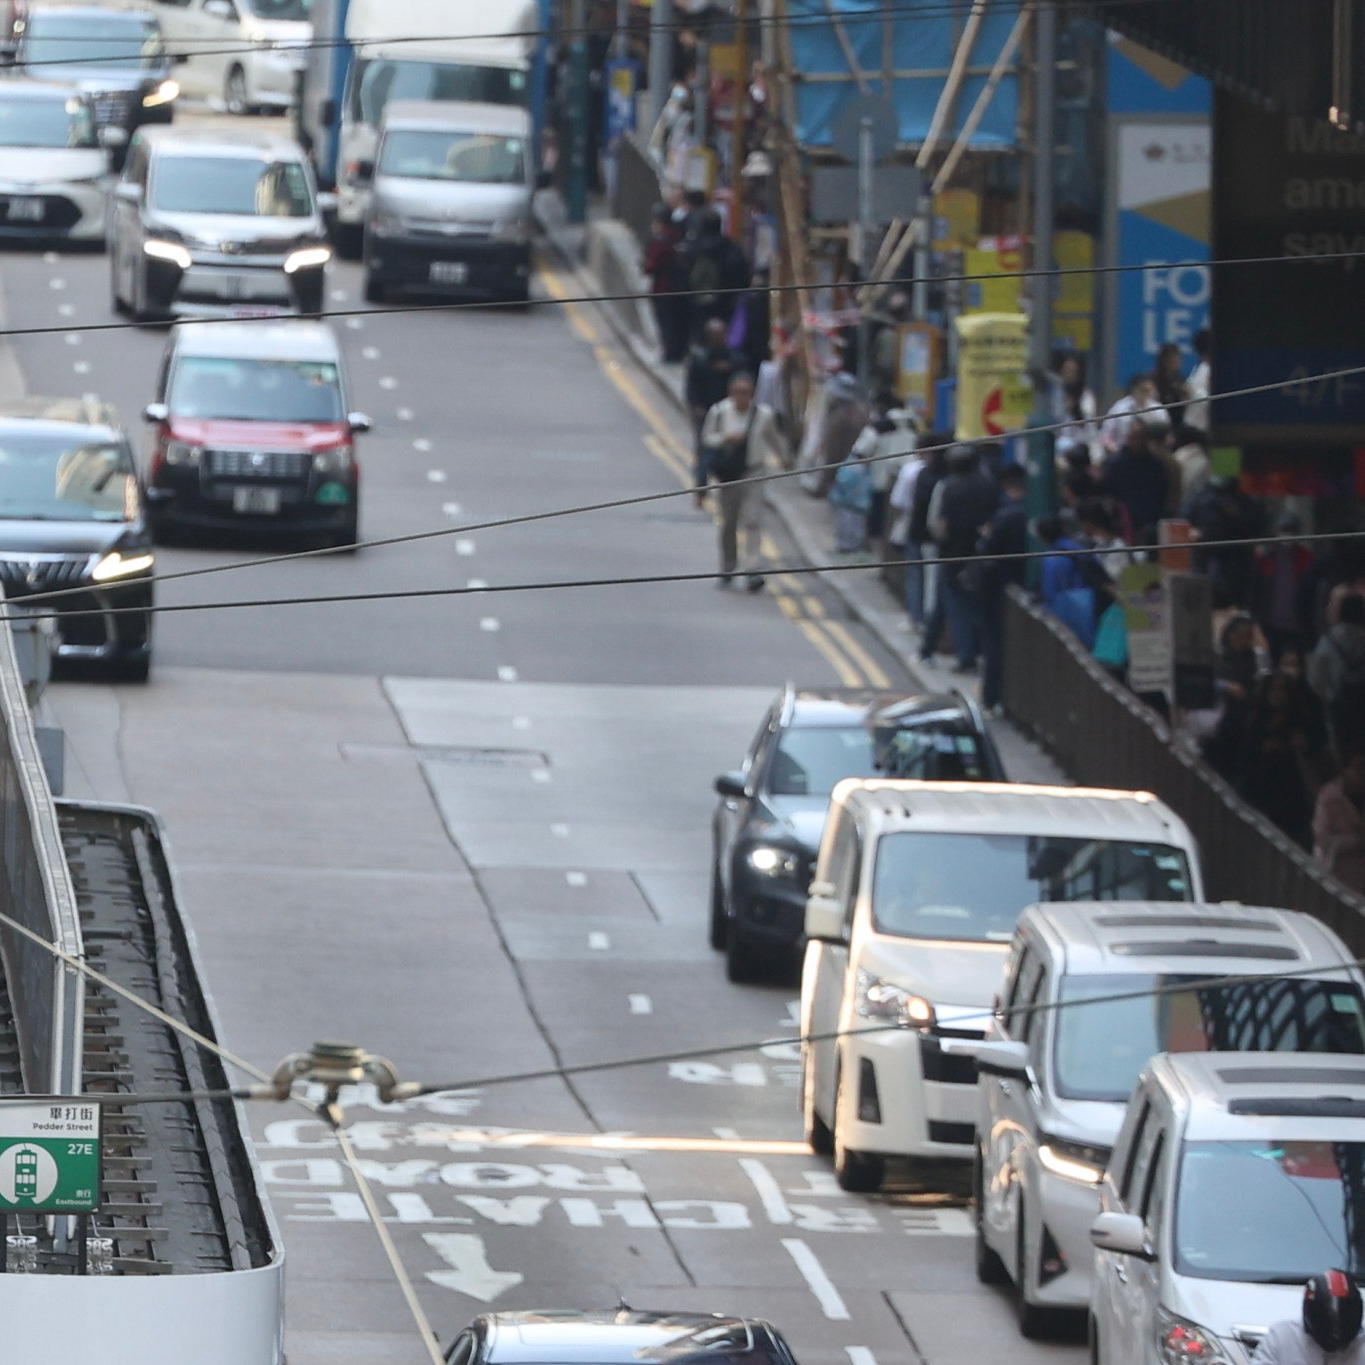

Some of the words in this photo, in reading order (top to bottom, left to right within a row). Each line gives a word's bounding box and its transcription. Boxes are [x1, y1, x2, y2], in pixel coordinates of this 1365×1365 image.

[50, 1107, 93, 1121] 畢打街
[32, 1122, 64, 1131] Pedder
[66, 1123, 93, 1132] Street
[67, 1144, 93, 1155] 27E
